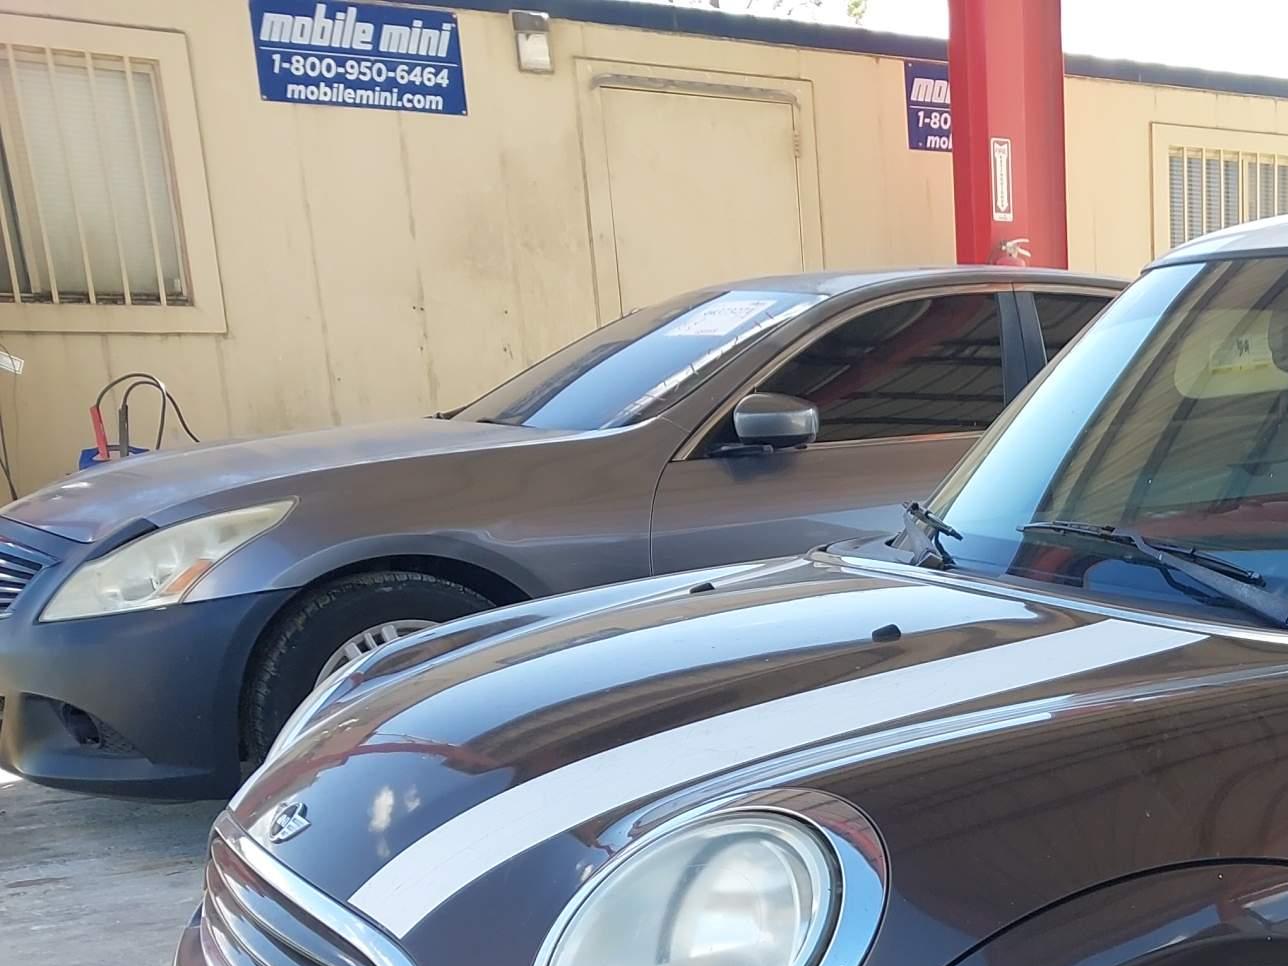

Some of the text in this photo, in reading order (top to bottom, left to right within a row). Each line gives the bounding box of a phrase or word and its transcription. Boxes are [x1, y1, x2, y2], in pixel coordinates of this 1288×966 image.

[260, 3, 452, 57] mobile mini
[271, 54, 450, 87] 1-800-950-6464
[286, 82, 444, 111] mobilemini.com
